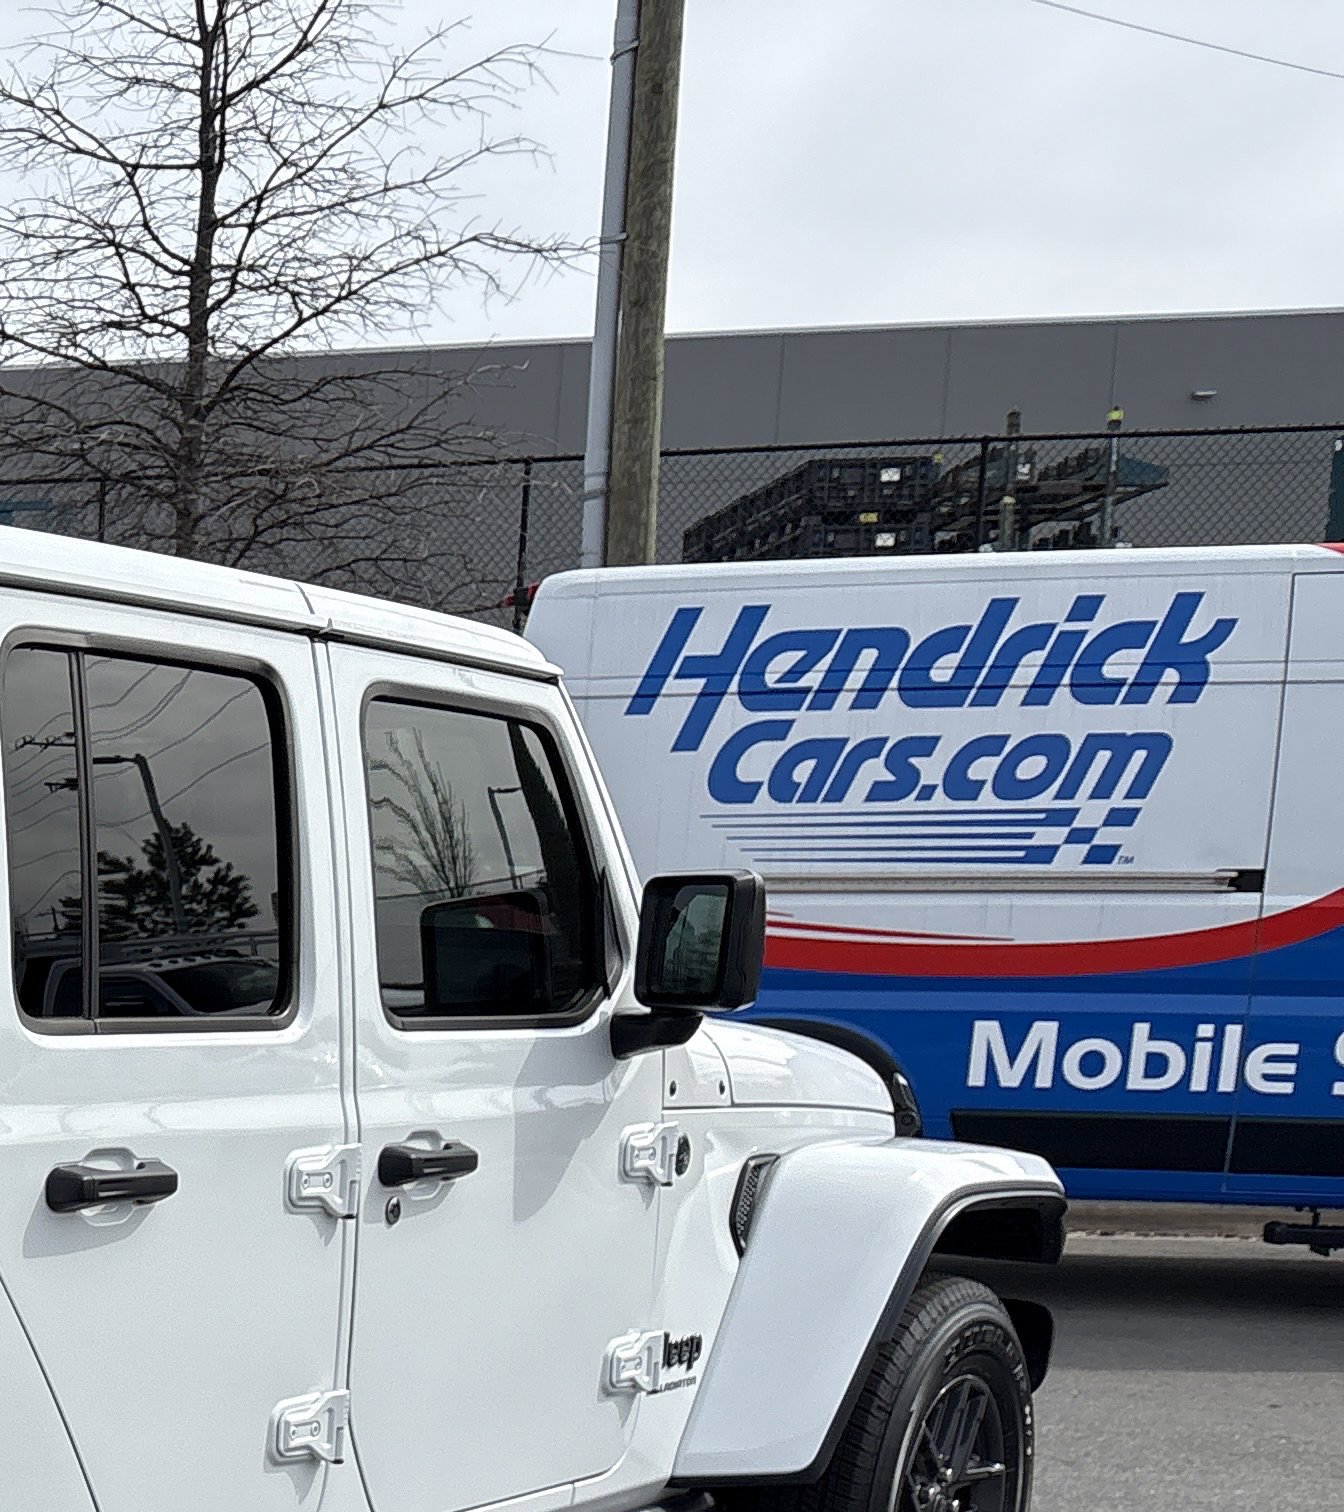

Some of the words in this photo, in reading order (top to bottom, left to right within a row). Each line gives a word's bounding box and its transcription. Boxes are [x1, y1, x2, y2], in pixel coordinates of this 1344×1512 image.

[625, 591, 1238, 751] Hendrick
[708, 718, 1173, 803] Cars.com
[967, 1020, 1301, 1095] Mobile
